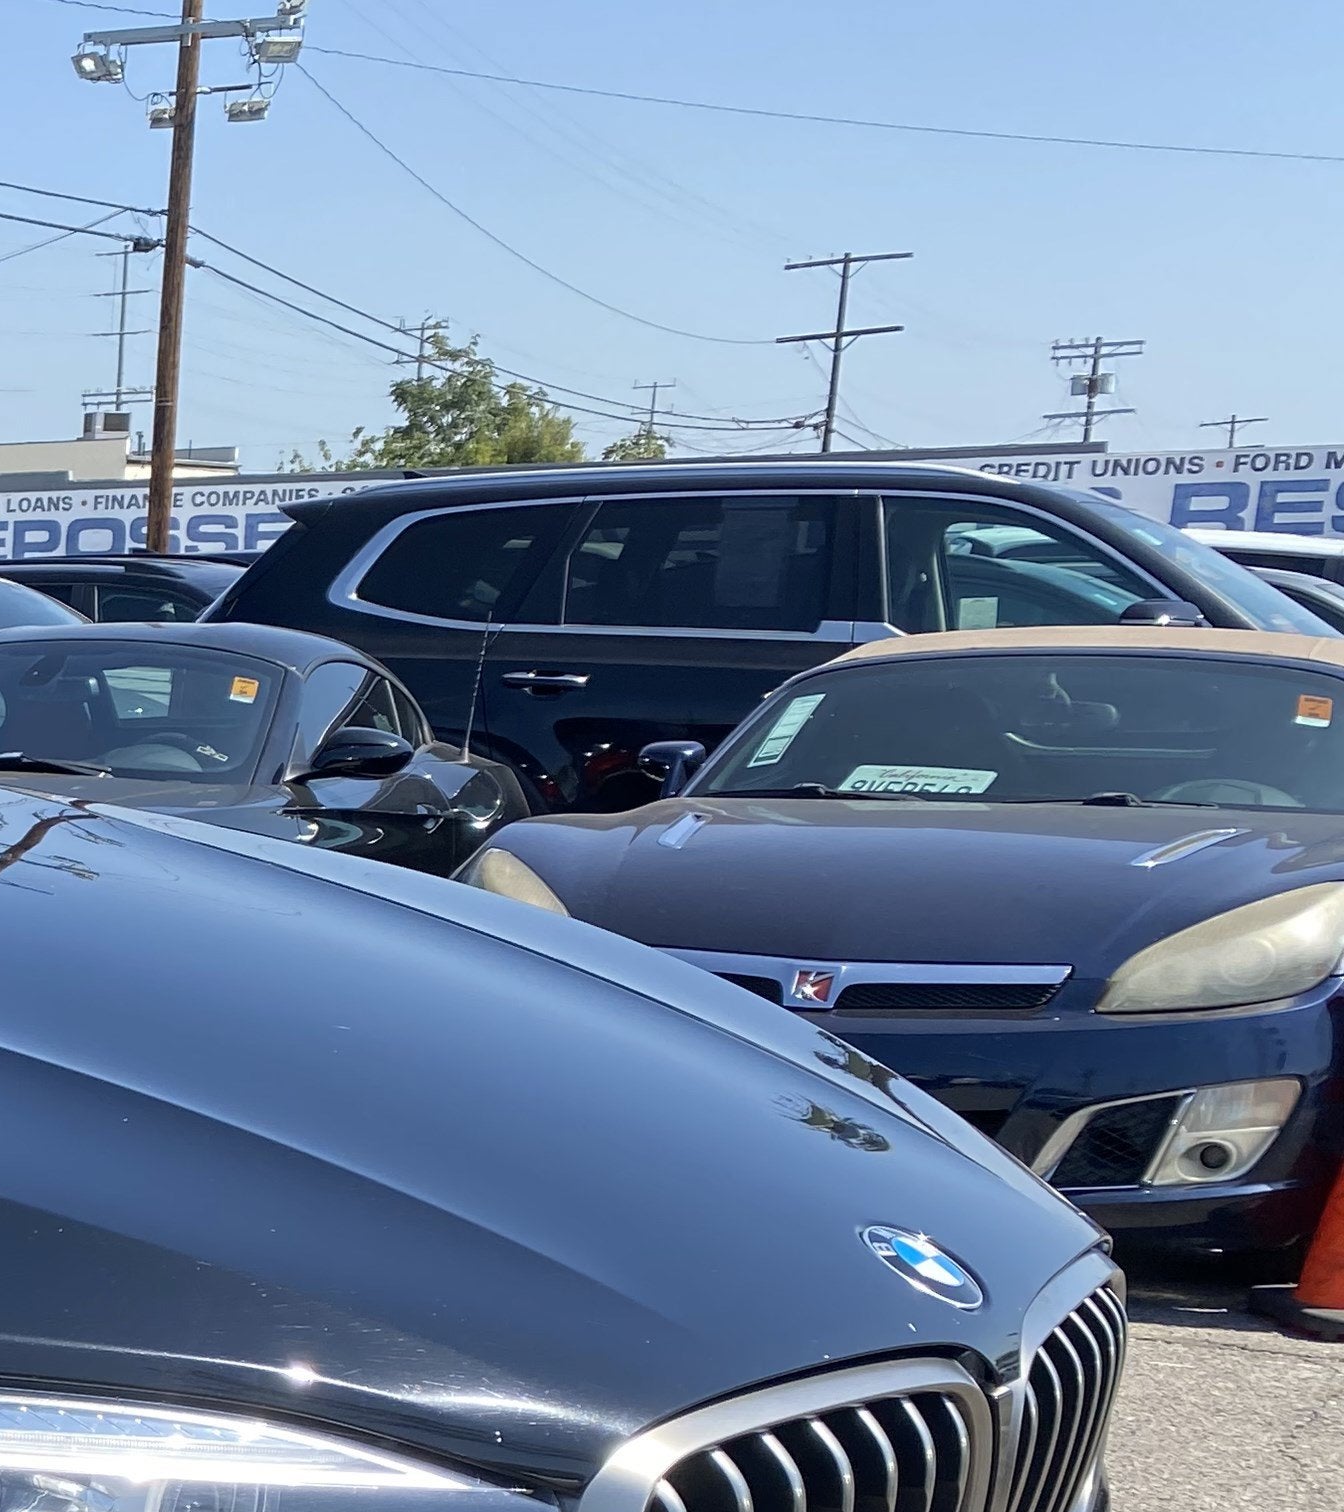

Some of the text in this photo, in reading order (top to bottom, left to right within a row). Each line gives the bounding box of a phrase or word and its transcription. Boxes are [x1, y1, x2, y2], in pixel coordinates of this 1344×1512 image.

[1091, 455, 1206, 478] UNIONS
[1233, 452, 1314, 472] FORD
[6, 496, 73, 513] LOANS
[191, 487, 320, 508] COMPANIES
